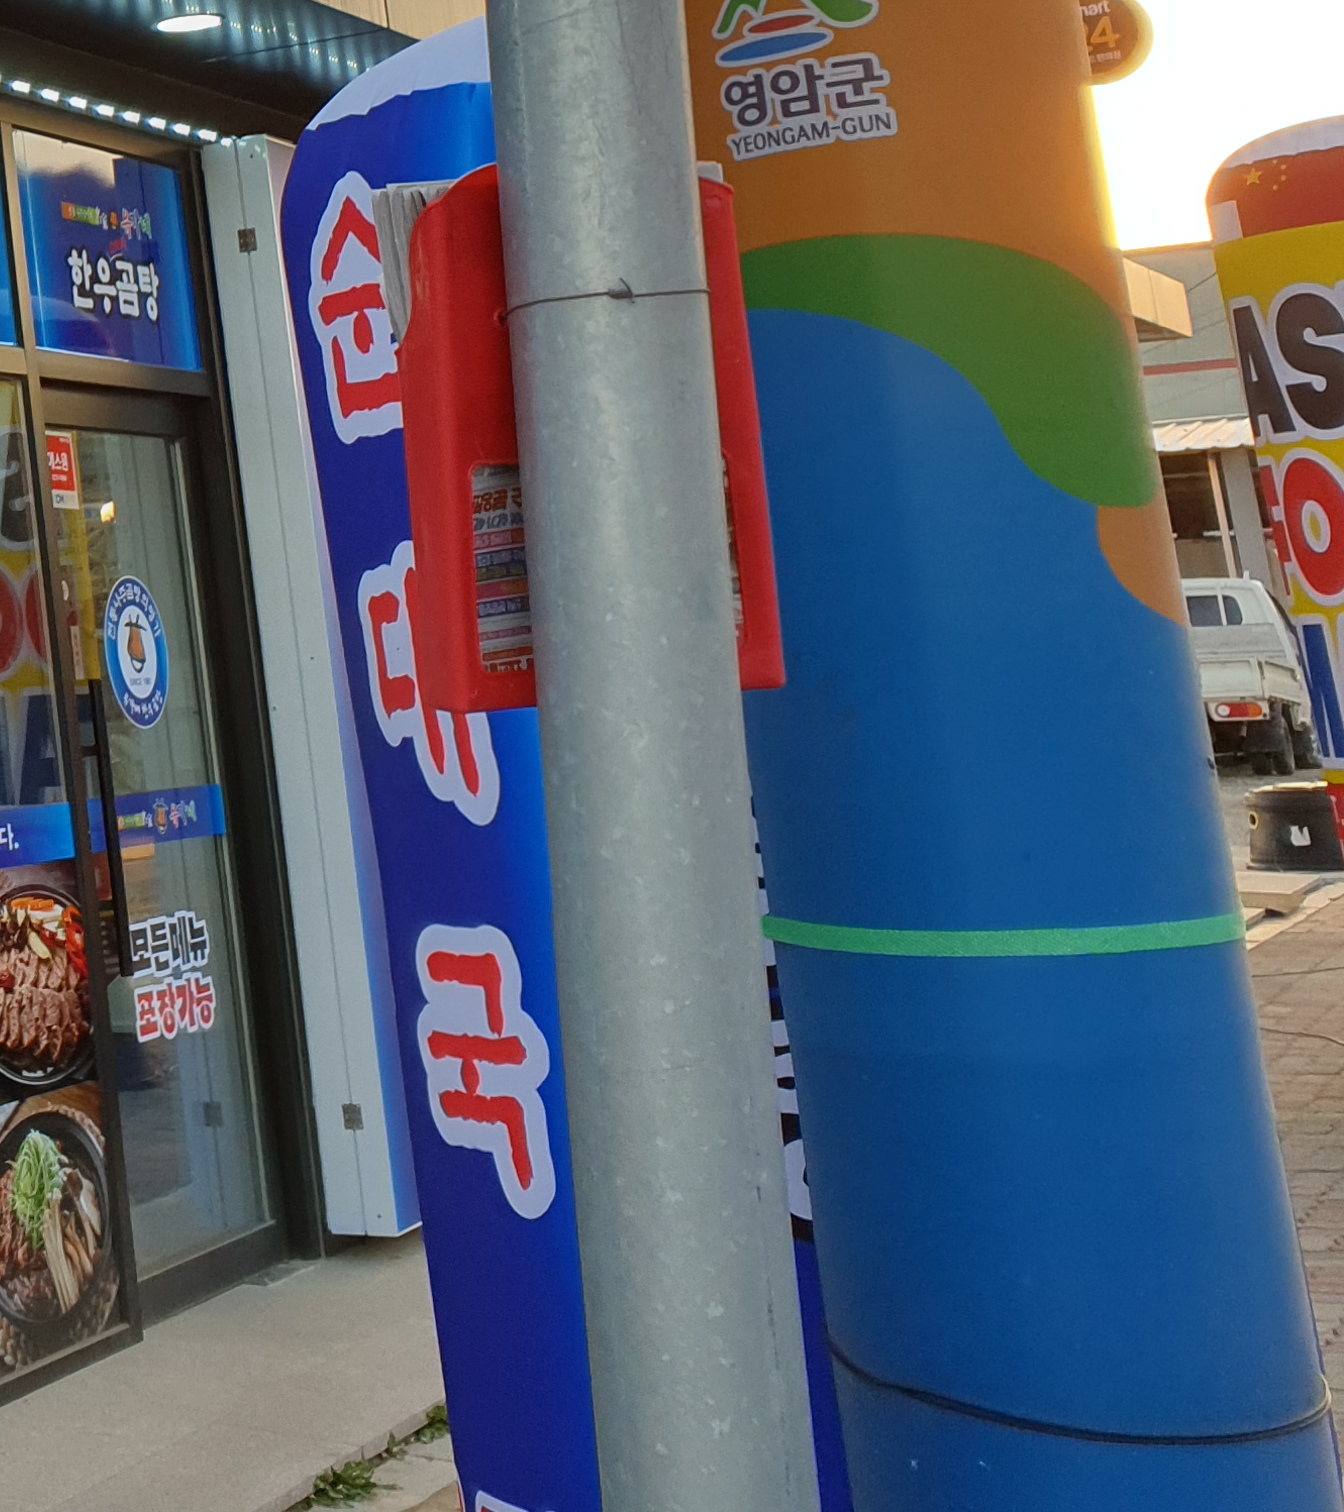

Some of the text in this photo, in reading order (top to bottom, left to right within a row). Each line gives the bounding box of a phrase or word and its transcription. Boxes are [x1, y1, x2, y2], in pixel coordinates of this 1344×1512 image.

[724, 56, 886, 128] 영암군
[731, 112, 893, 158] YEONGAM-GUN
[67, 249, 159, 321] 한우곰탕
[137, 975, 214, 1038] 포장가능
